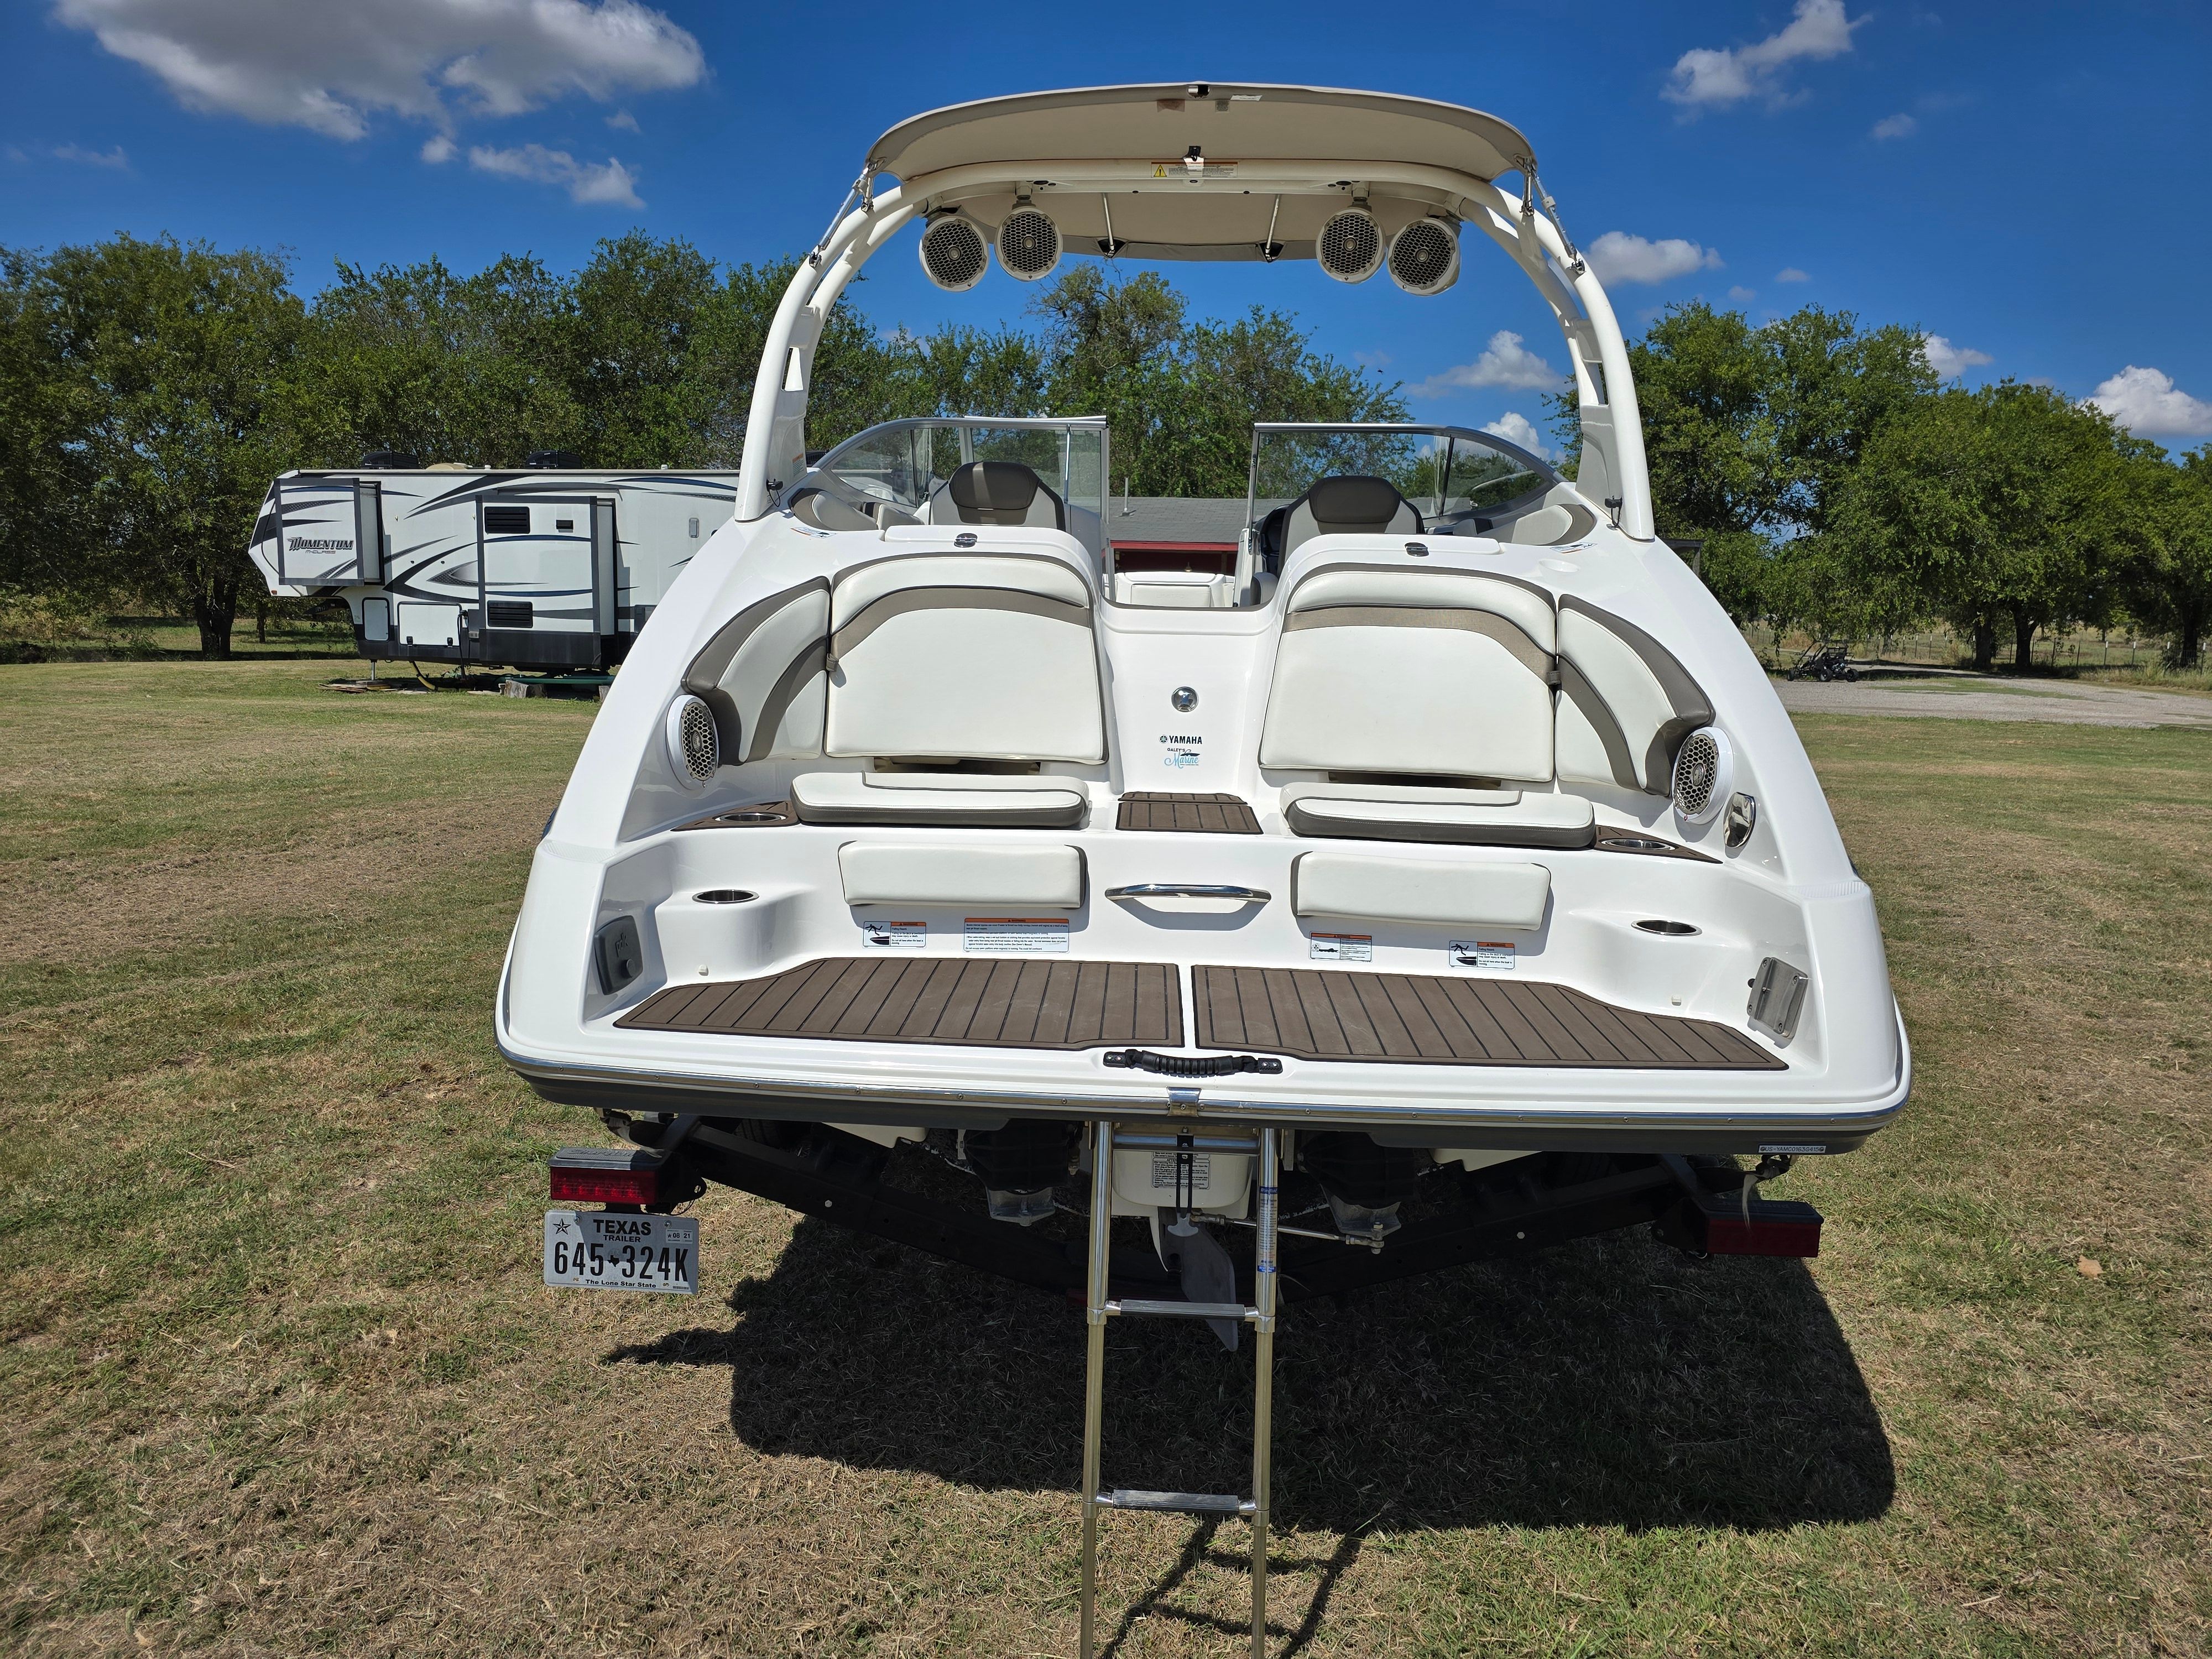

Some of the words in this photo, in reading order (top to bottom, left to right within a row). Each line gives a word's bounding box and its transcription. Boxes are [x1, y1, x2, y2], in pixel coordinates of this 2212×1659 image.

[286, 537, 354, 551] MOMENTUM
[1168, 735, 1202, 744] YAMAHA
[1164, 752, 1199, 769] Marine
[593, 1219, 651, 1236] TEXAS
[603, 1234, 641, 1243] TRAILER
